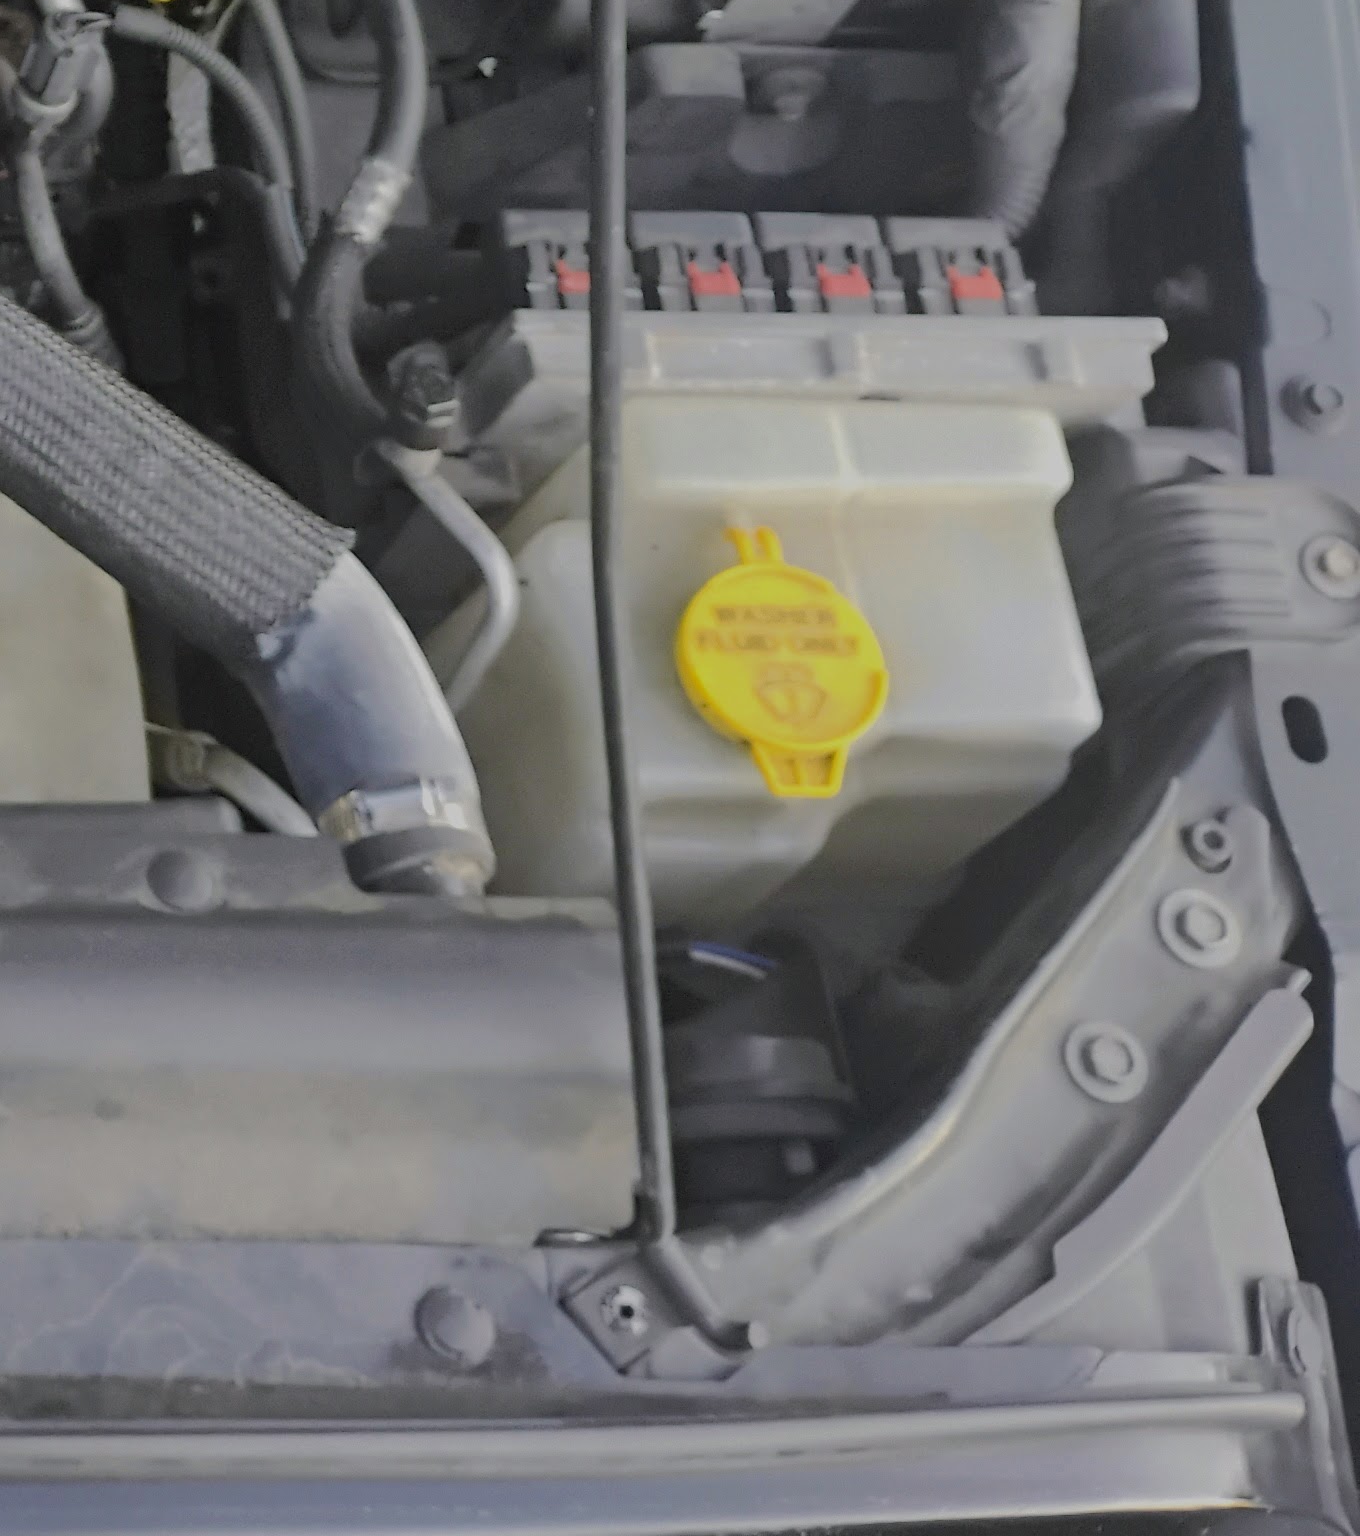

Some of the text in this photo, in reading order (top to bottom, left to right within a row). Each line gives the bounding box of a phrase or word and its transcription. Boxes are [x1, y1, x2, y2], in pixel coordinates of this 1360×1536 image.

[711, 604, 839, 626] WASHER
[694, 628, 861, 658] FLUID ONLY
